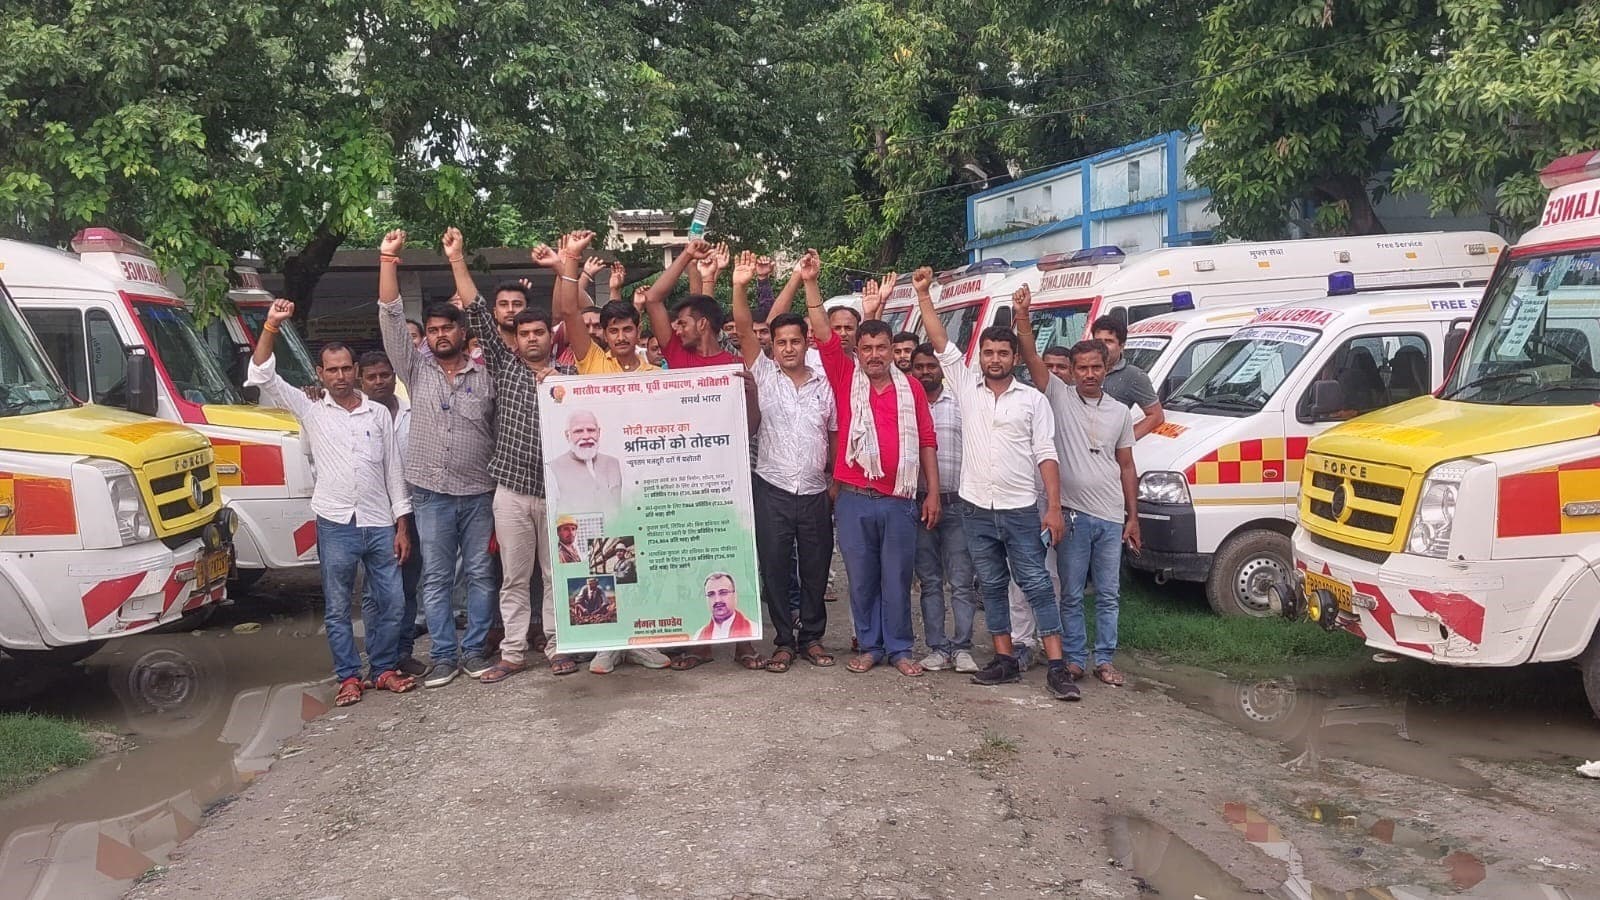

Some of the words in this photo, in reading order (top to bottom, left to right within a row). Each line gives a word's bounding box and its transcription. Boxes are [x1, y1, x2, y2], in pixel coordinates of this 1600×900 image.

[1376, 241, 1393, 249] Free
[1394, 240, 1424, 248] Service
[1430, 300, 1467, 309] FREE
[573, 384, 600, 396] भारतीय
[698, 376, 729, 388] मोतिहारी
[680, 393, 700, 405] समर्थ
[702, 394, 721, 404] भारत
[623, 424, 643, 436] मोदी
[645, 424, 675, 435] सरकार
[677, 423, 690, 432] का
[624, 435, 666, 452] श्रमिकों
[669, 434, 686, 449] को
[689, 433, 730, 448] तोहफा
[174, 453, 204, 471] FORCE
[1324, 460, 1367, 478] FORCE
